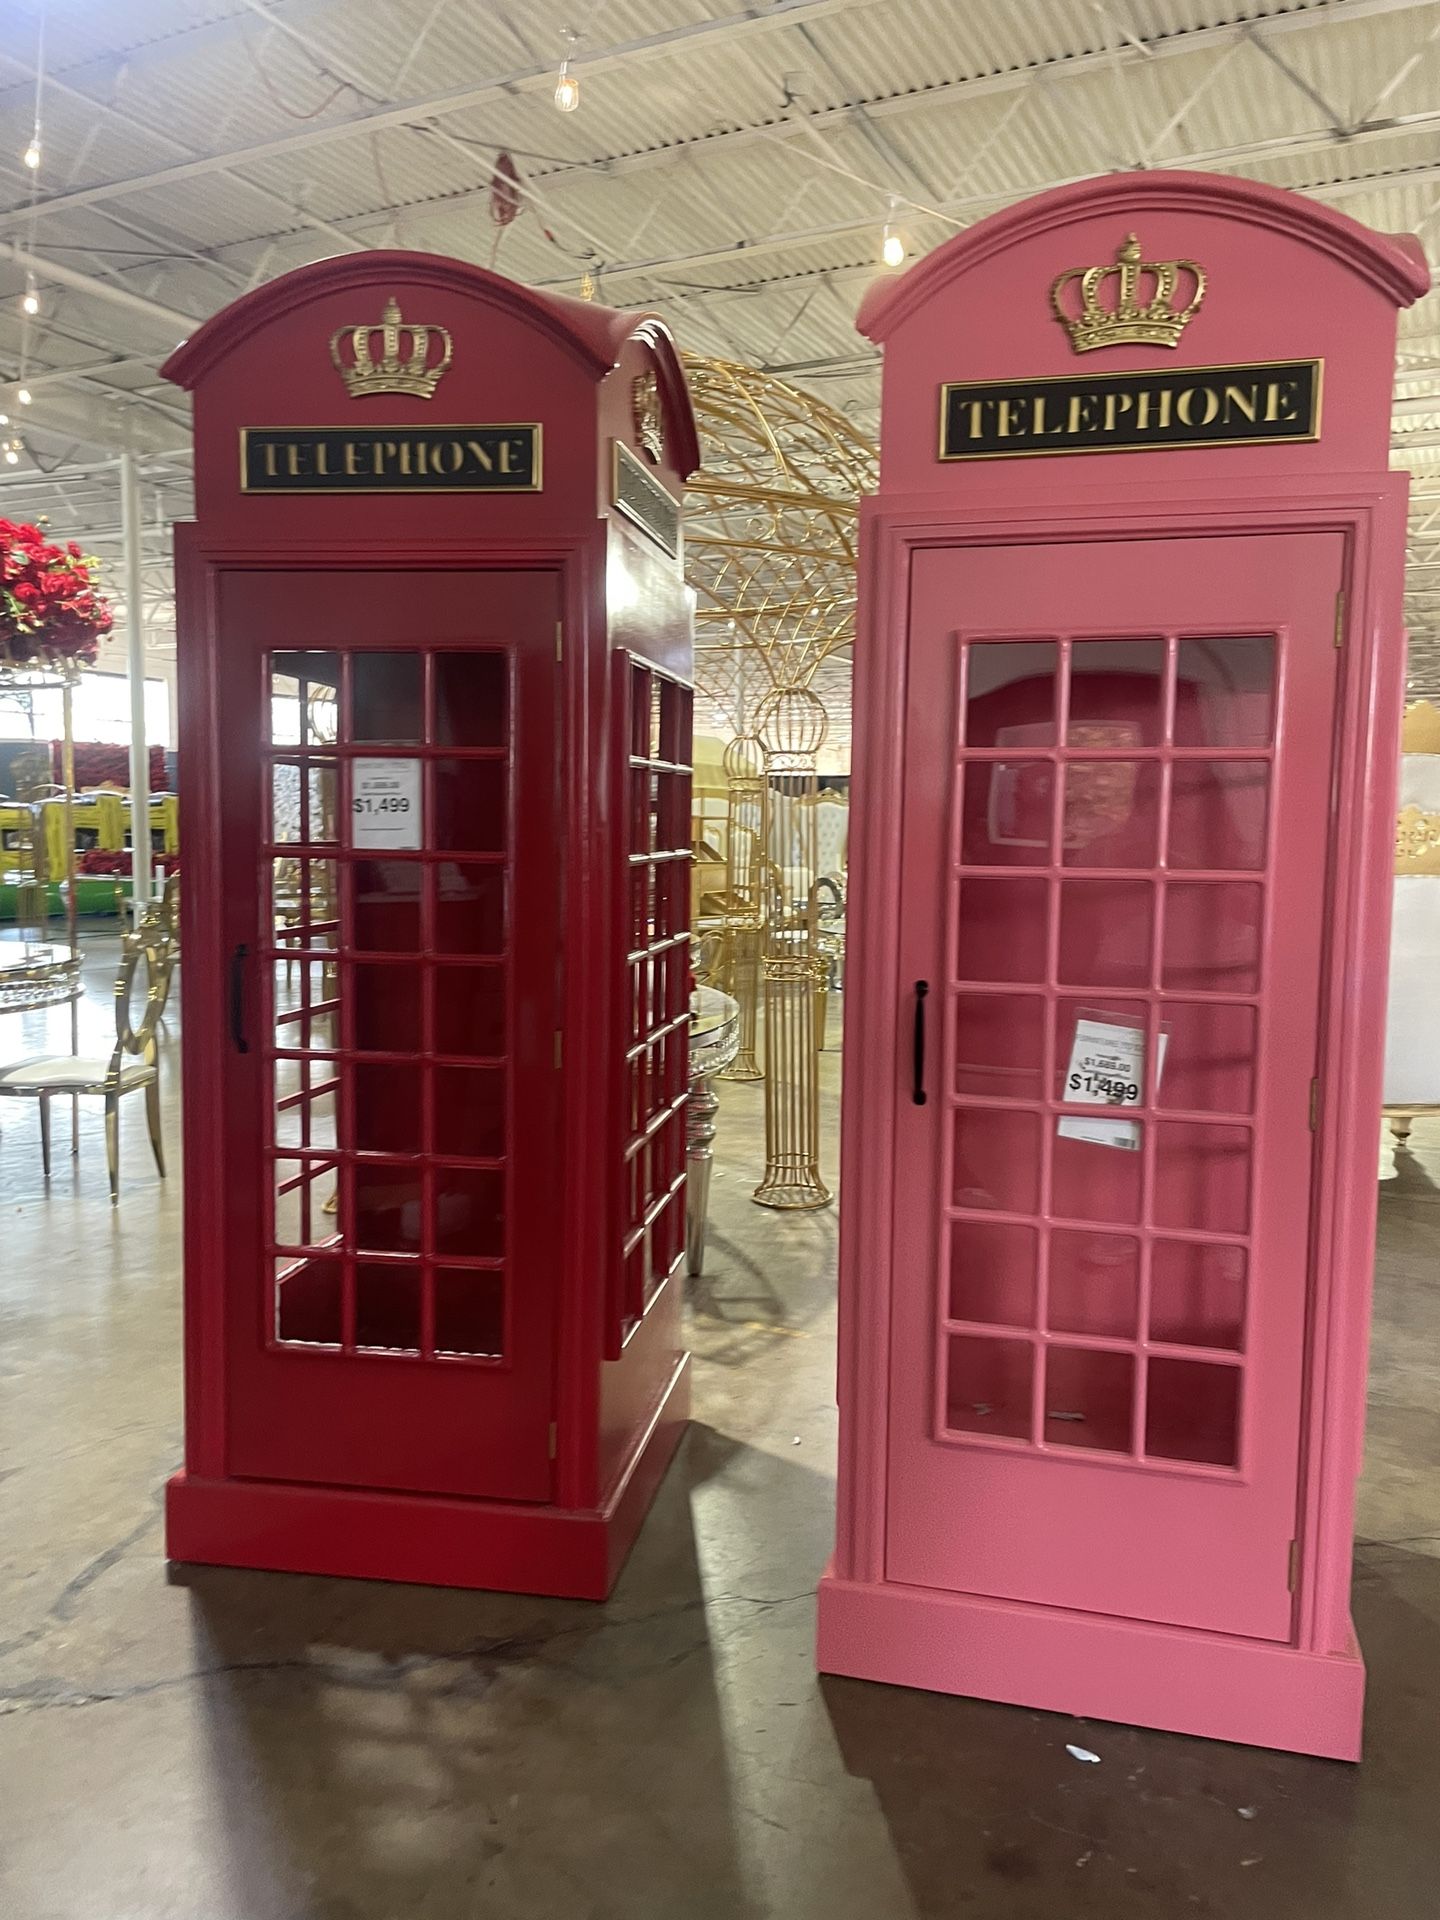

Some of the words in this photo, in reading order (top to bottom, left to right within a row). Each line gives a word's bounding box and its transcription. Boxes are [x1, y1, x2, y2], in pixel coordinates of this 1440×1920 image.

[959, 382, 1298, 439] TELEPHONE
[254, 439, 527, 476] TELEPHONE
[353, 798, 410, 815] $1,499
[1069, 1073, 1138, 1101] $1,499
